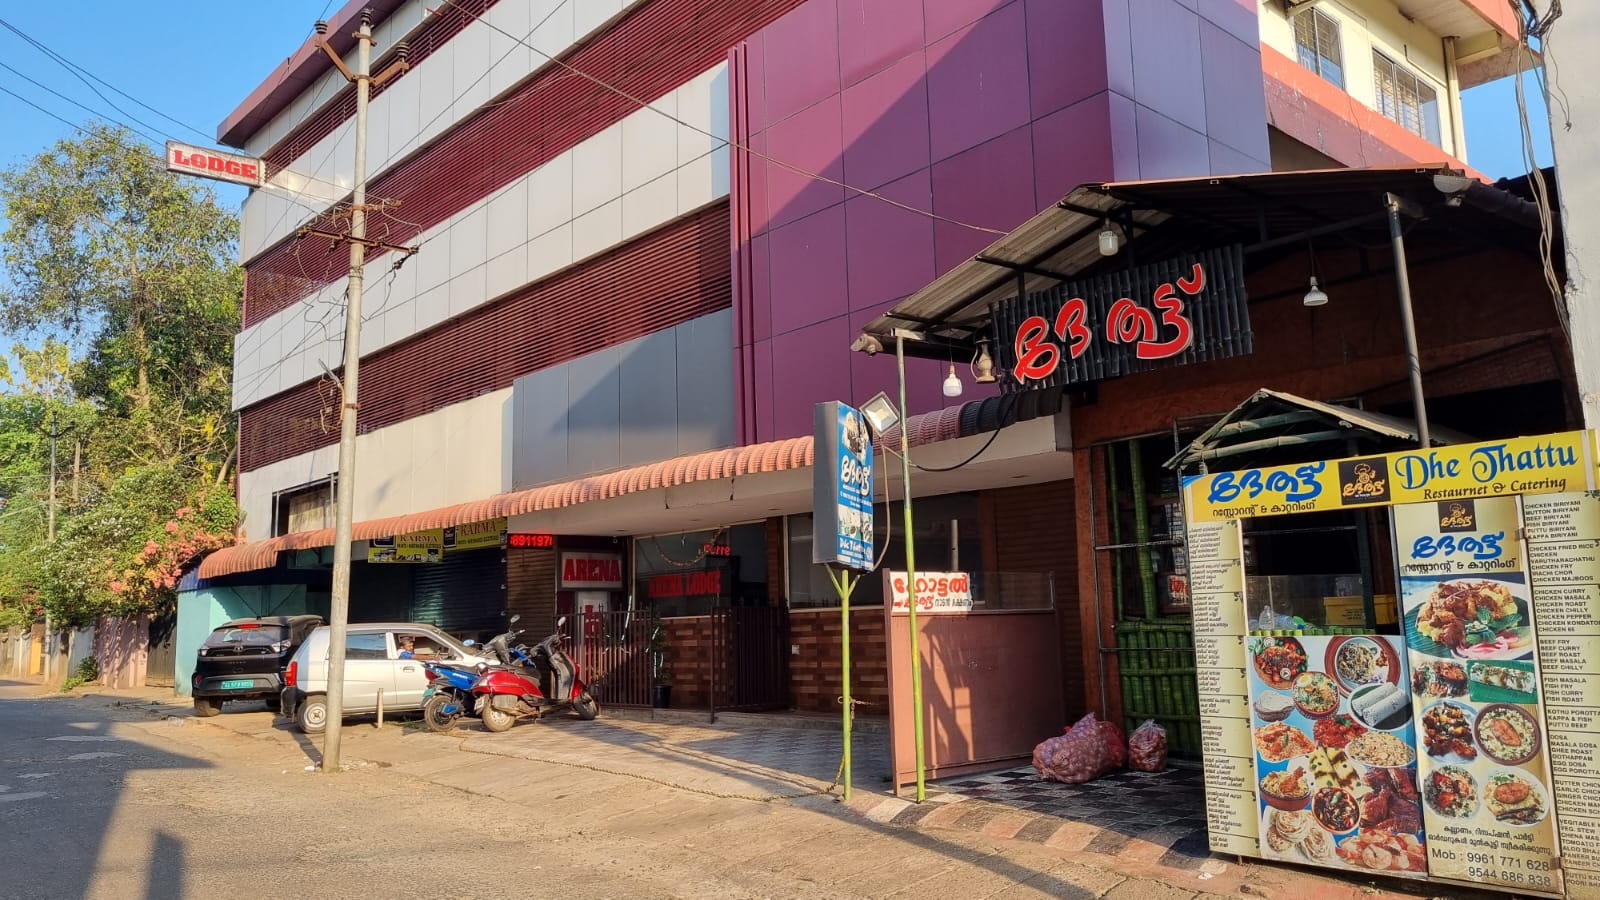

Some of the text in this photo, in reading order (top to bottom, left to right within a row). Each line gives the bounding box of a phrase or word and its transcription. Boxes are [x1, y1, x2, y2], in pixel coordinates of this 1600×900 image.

[174, 149, 257, 180] LODGE
[1395, 441, 1580, 489] Dhe Thattu
[1423, 485, 1488, 500] Restaurnet
[1510, 477, 1567, 493] Catering
[400, 535, 438, 543] KARMA
[461, 521, 497, 537] KARMA
[563, 558, 621, 582] ARENA
[1554, 779, 1581, 787] BUTTER
[1432, 848, 1456, 860] Mob
[1467, 852, 1496, 865] 9961
[1500, 856, 1521, 868] 771
[1526, 859, 1550, 872] 628
[1468, 866, 1552, 887] 9544 686 838
